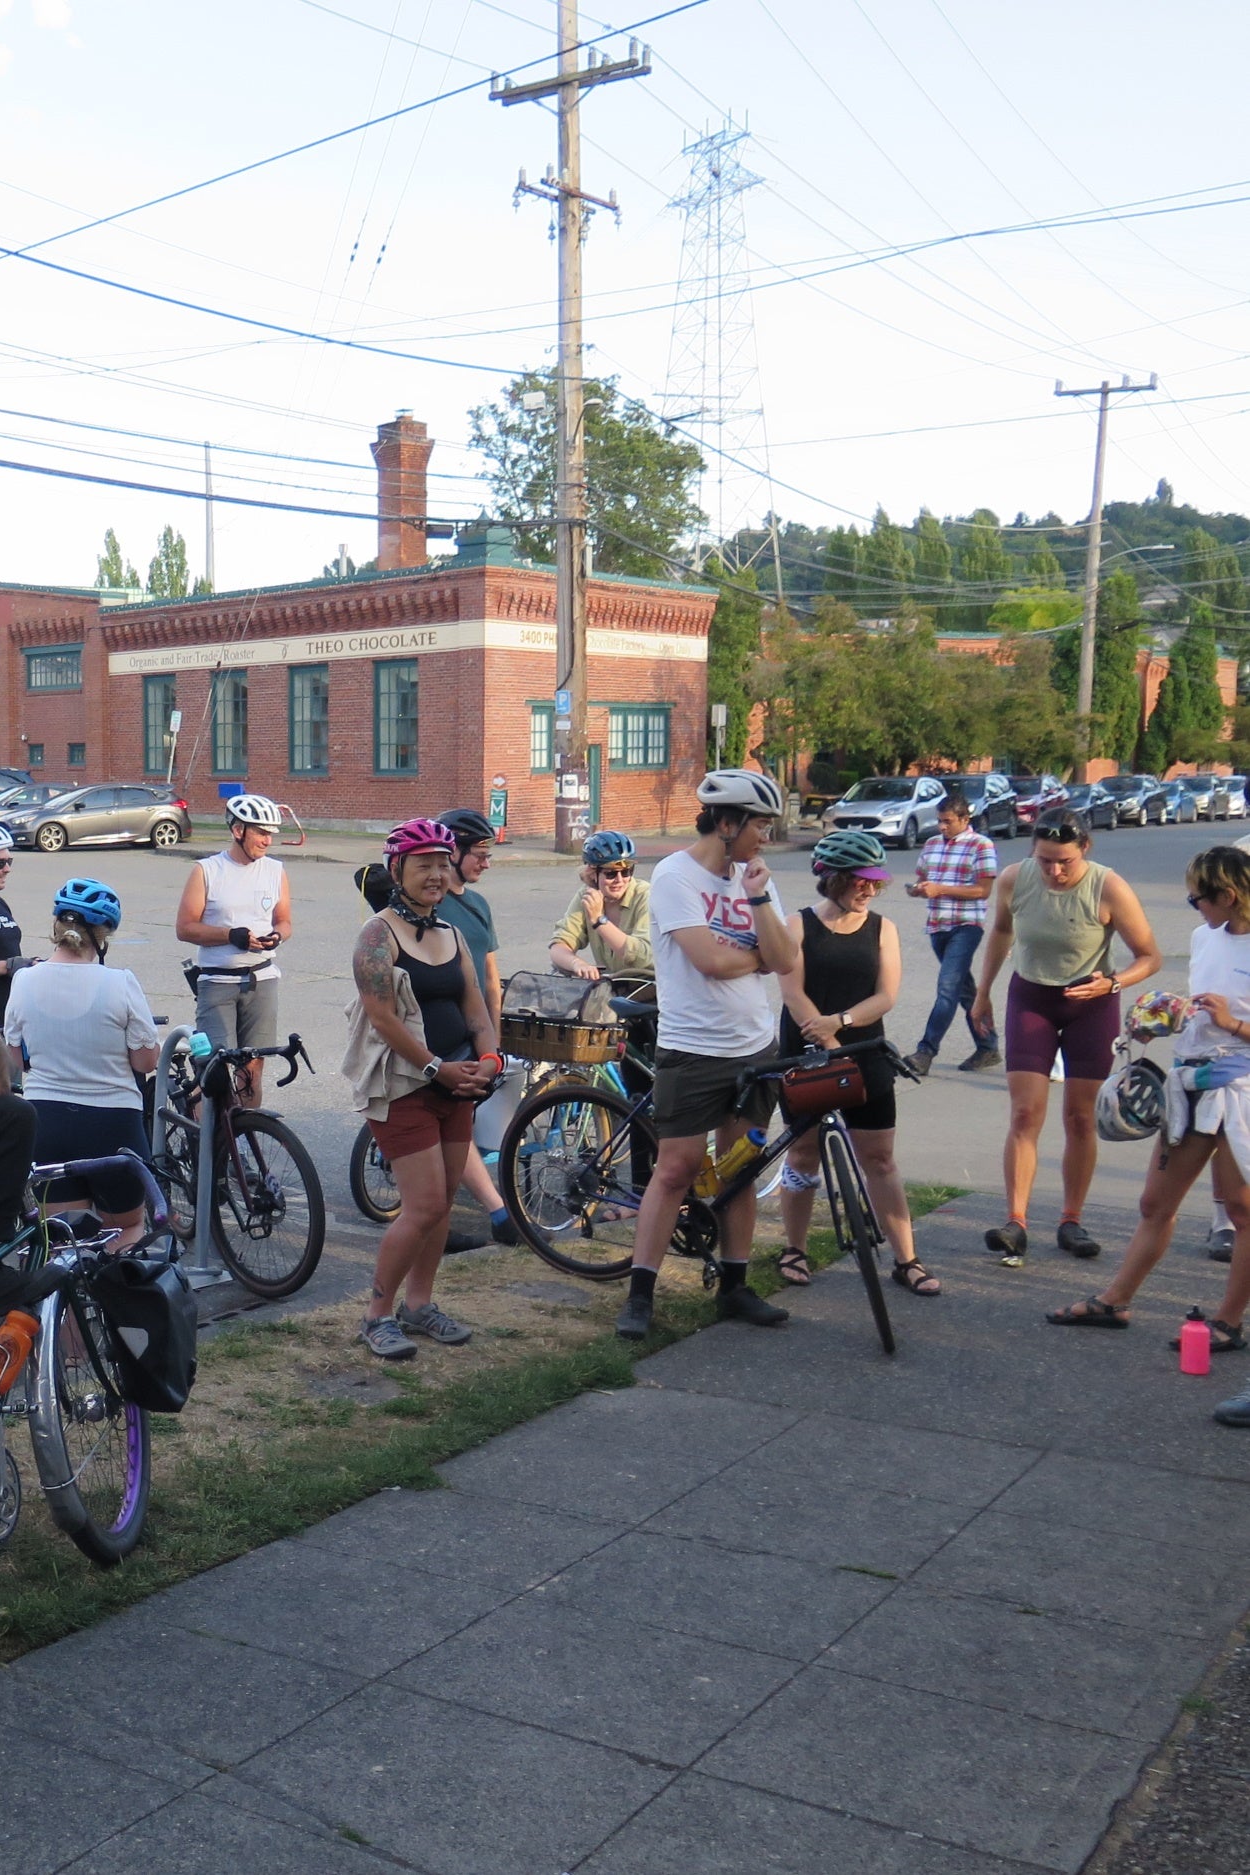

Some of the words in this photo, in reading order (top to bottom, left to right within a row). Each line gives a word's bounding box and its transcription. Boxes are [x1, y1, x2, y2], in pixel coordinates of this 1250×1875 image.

[306, 639, 344, 655] THEO
[348, 631, 438, 651] CHOCOLATE
[519, 629, 542, 644] 3400
[129, 656, 158, 670] Organic
[161, 653, 174, 665] and
[223, 649, 255, 661] Roaster
[490, 801, 505, 817] M
[701, 891, 753, 931] YES
